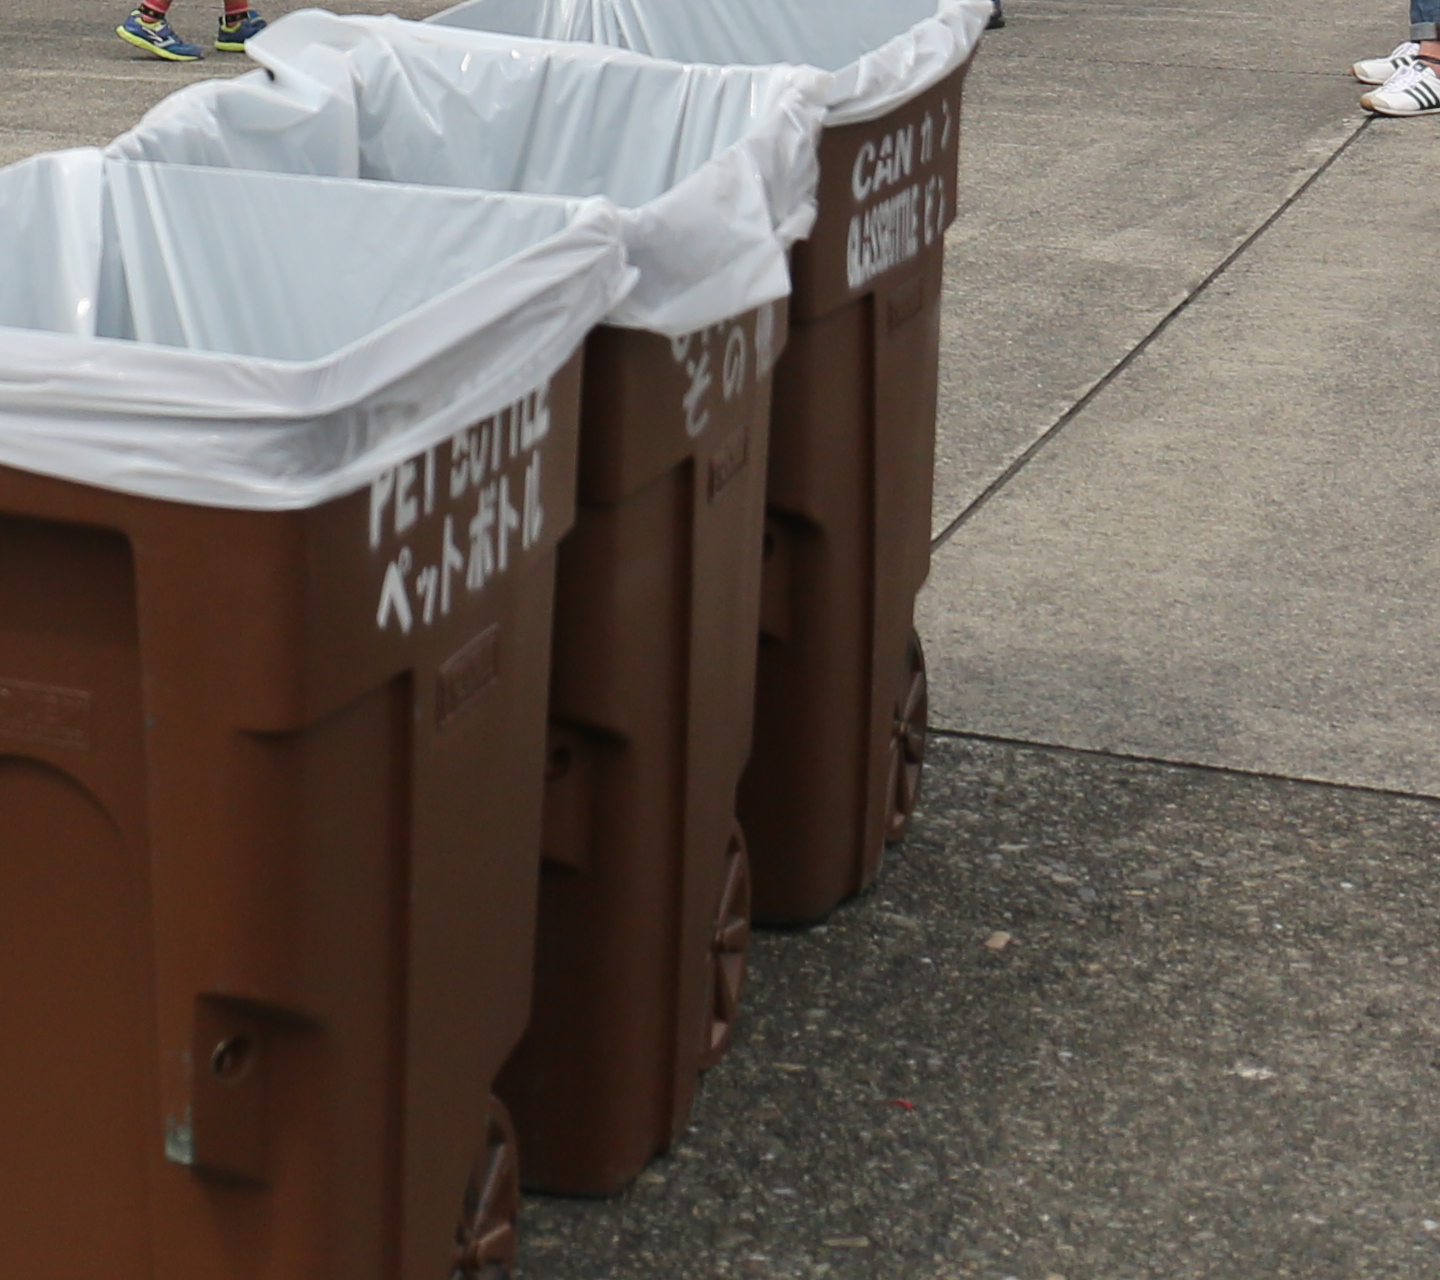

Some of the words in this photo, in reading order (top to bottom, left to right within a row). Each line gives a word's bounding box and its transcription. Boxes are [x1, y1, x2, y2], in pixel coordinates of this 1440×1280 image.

[852, 123, 914, 202] CAN
[376, 448, 544, 634] ペットボトル
